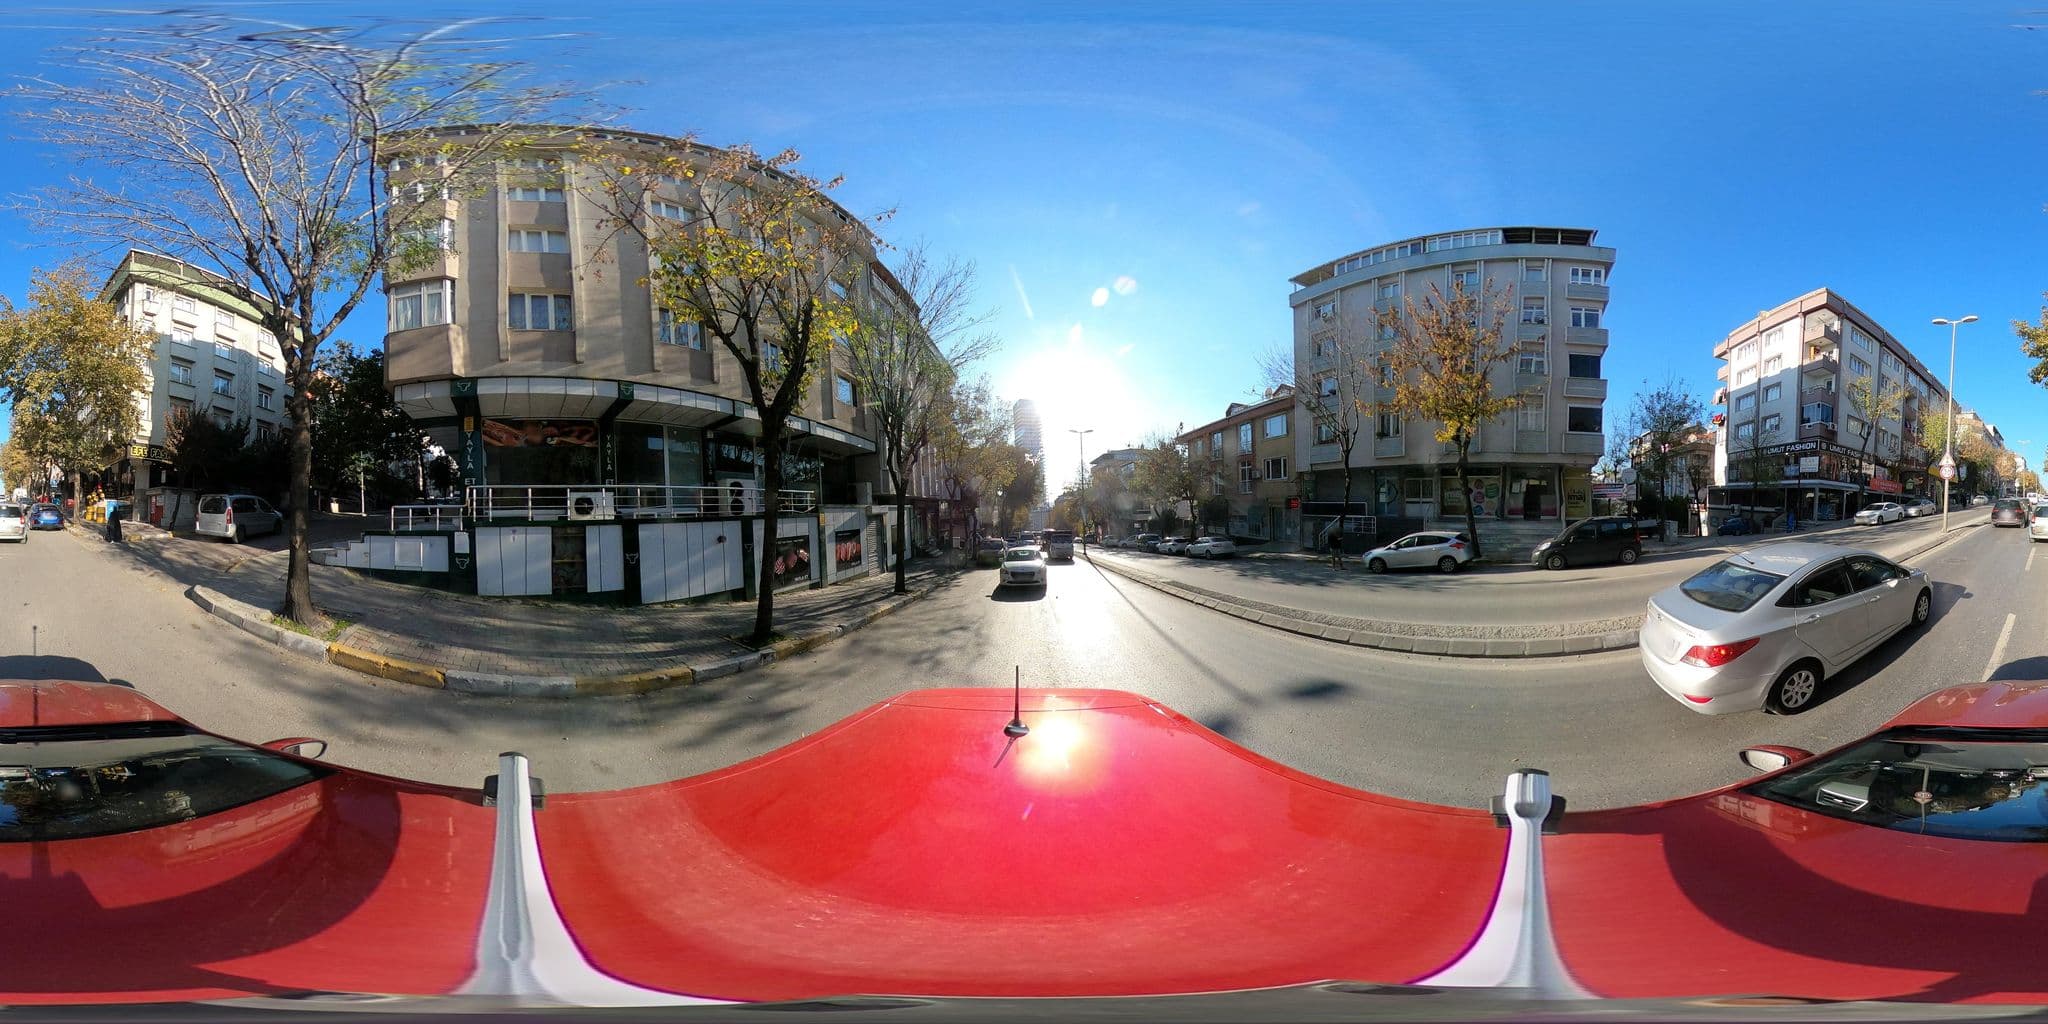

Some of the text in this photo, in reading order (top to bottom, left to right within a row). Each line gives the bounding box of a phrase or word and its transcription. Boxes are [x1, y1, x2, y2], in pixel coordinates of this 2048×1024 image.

[131, 446, 148, 457] EFE
[466, 431, 474, 470] YAYLA
[1767, 442, 1817, 454] UMUT FASHION
[1829, 444, 1847, 454] UMUT
